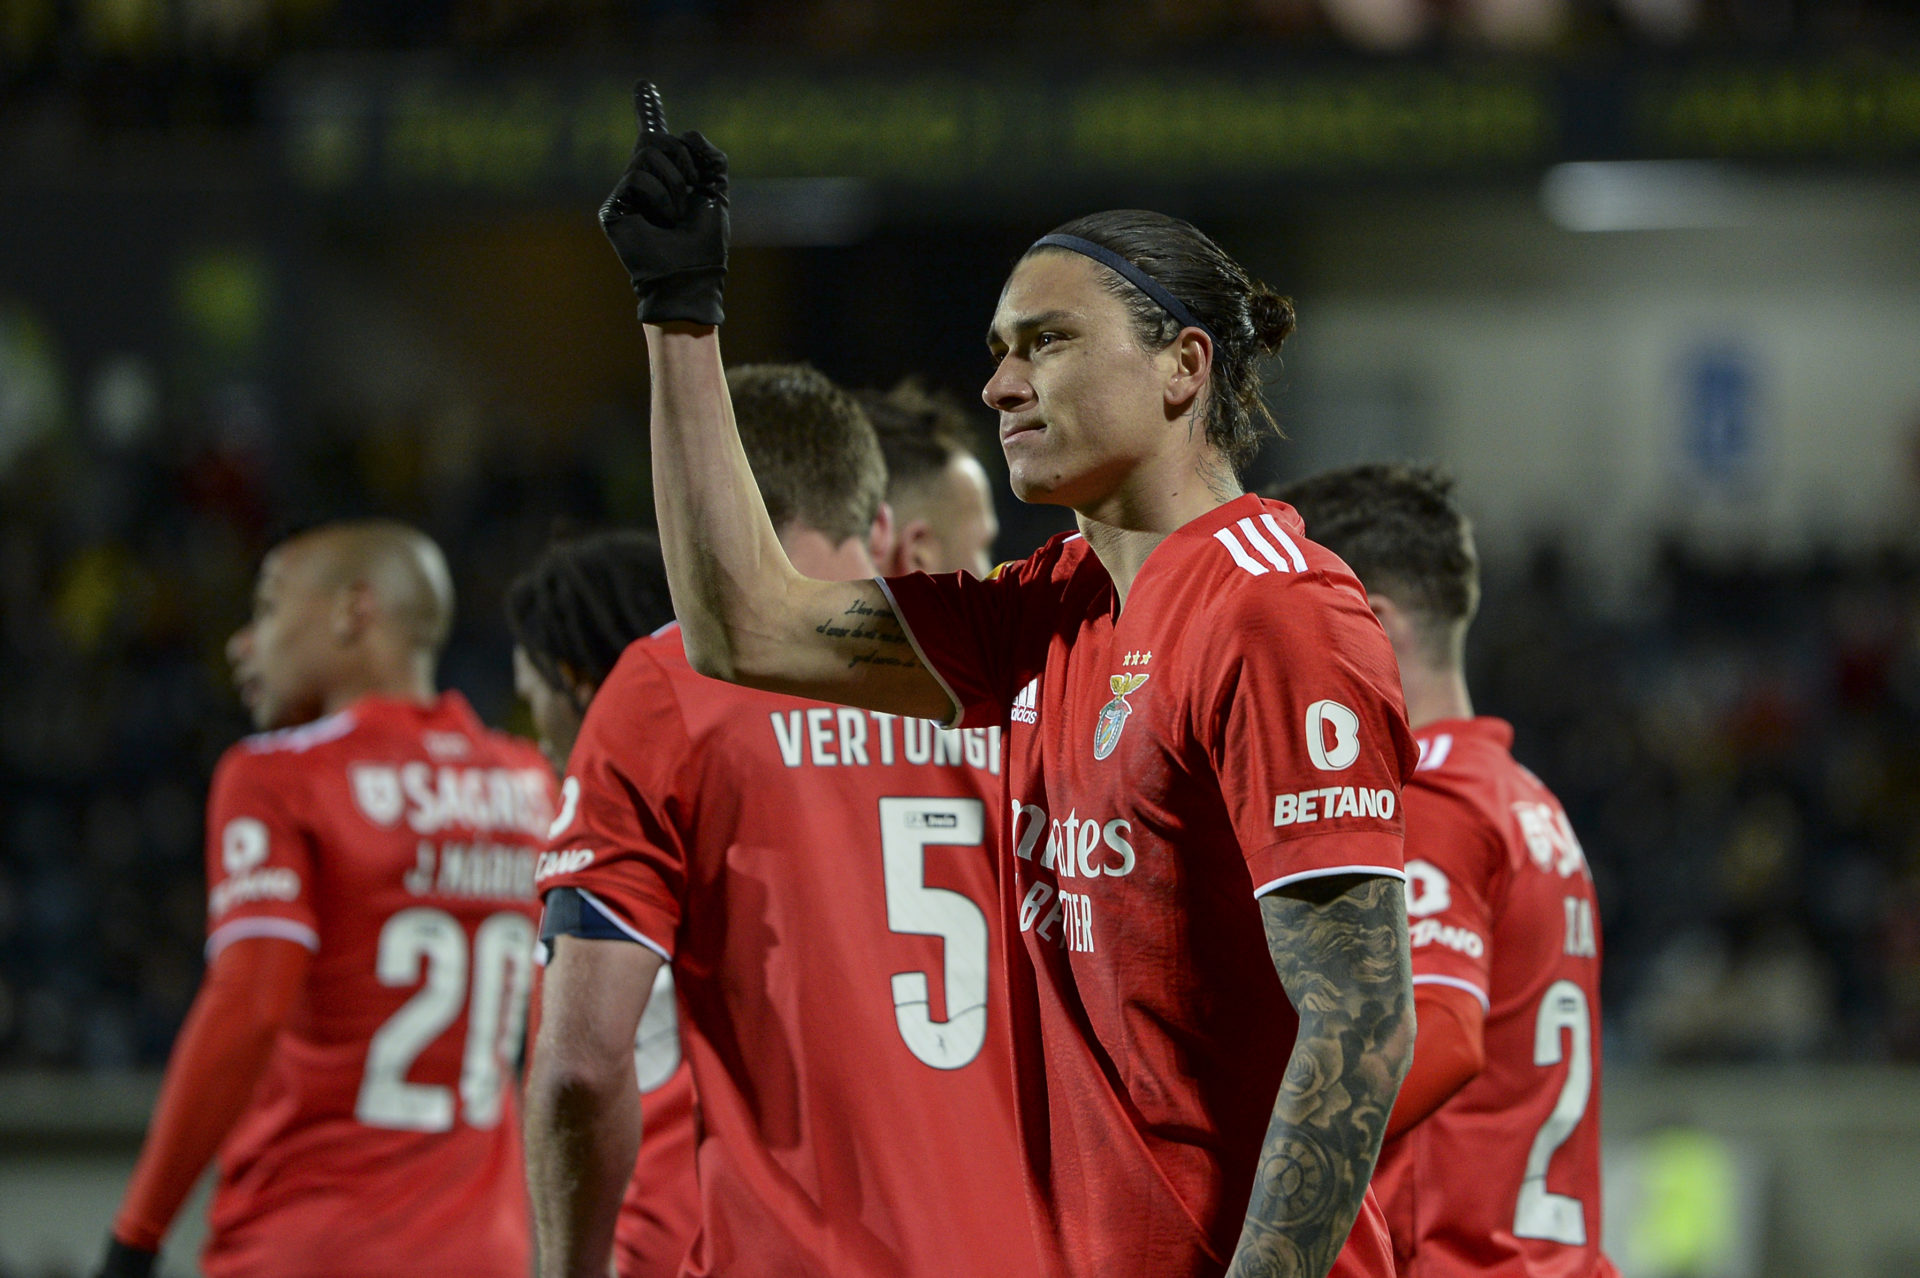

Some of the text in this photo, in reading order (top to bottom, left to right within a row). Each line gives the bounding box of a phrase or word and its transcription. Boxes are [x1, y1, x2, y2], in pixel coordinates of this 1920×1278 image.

[1273, 786, 1395, 827] BETANO
[354, 906, 535, 1133] 20
[877, 796, 989, 1071] 5
[1513, 979, 1592, 1246] 2
